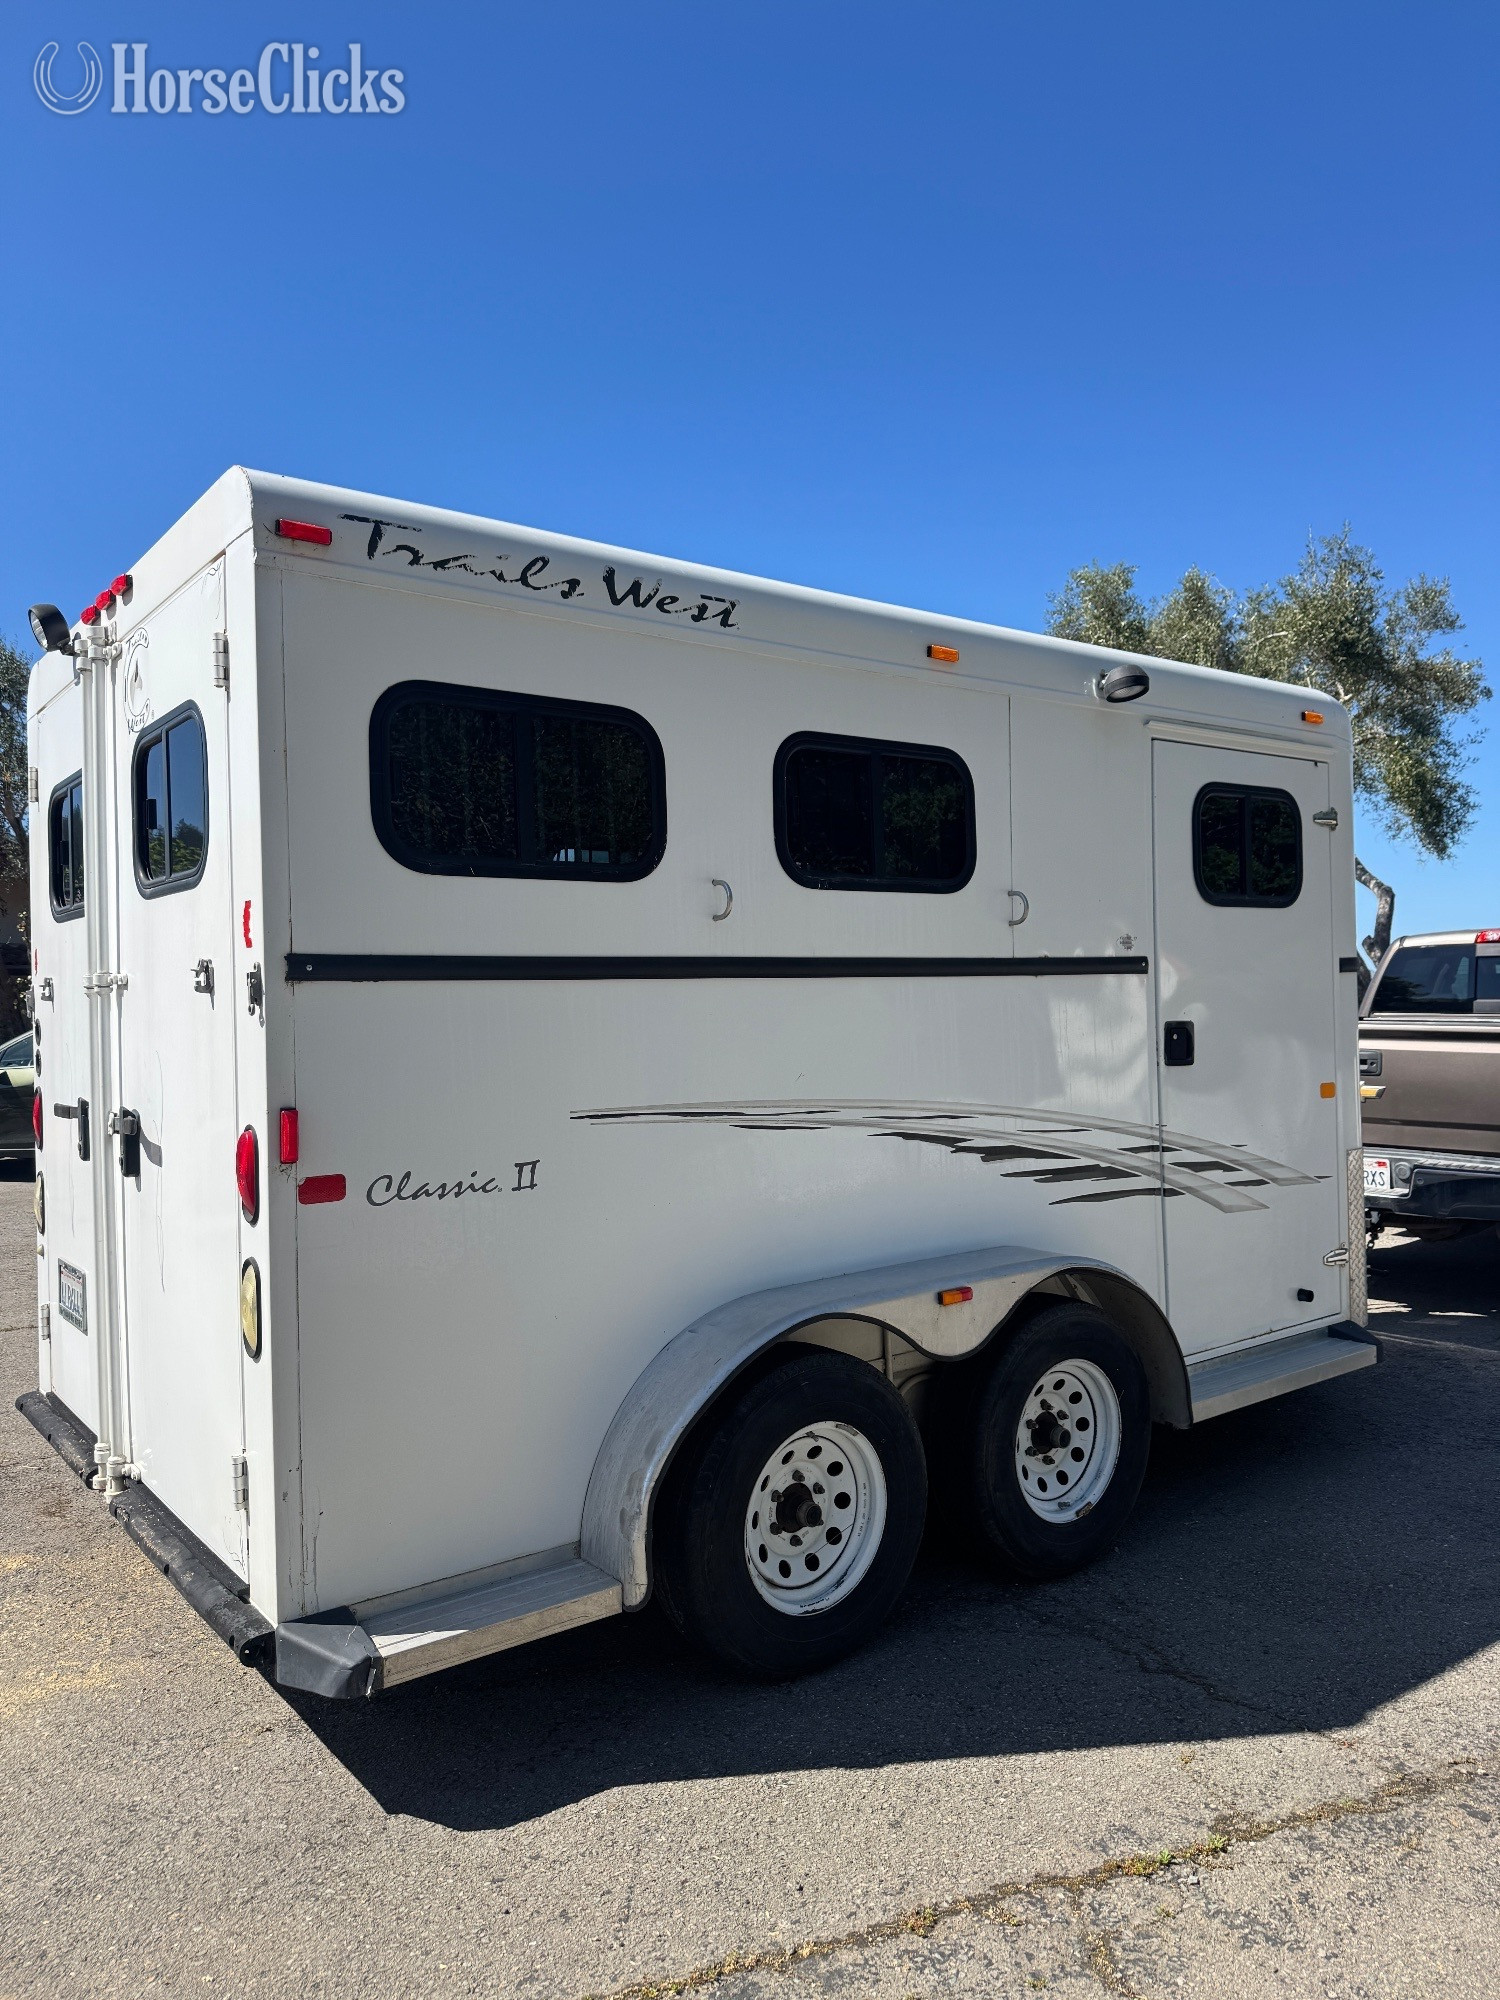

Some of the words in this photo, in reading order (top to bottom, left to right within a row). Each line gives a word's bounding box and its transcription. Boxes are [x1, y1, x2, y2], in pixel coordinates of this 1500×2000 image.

[336, 513, 585, 600] Trails
[602, 564, 741, 630] West
[511, 1159, 541, 1192] II
